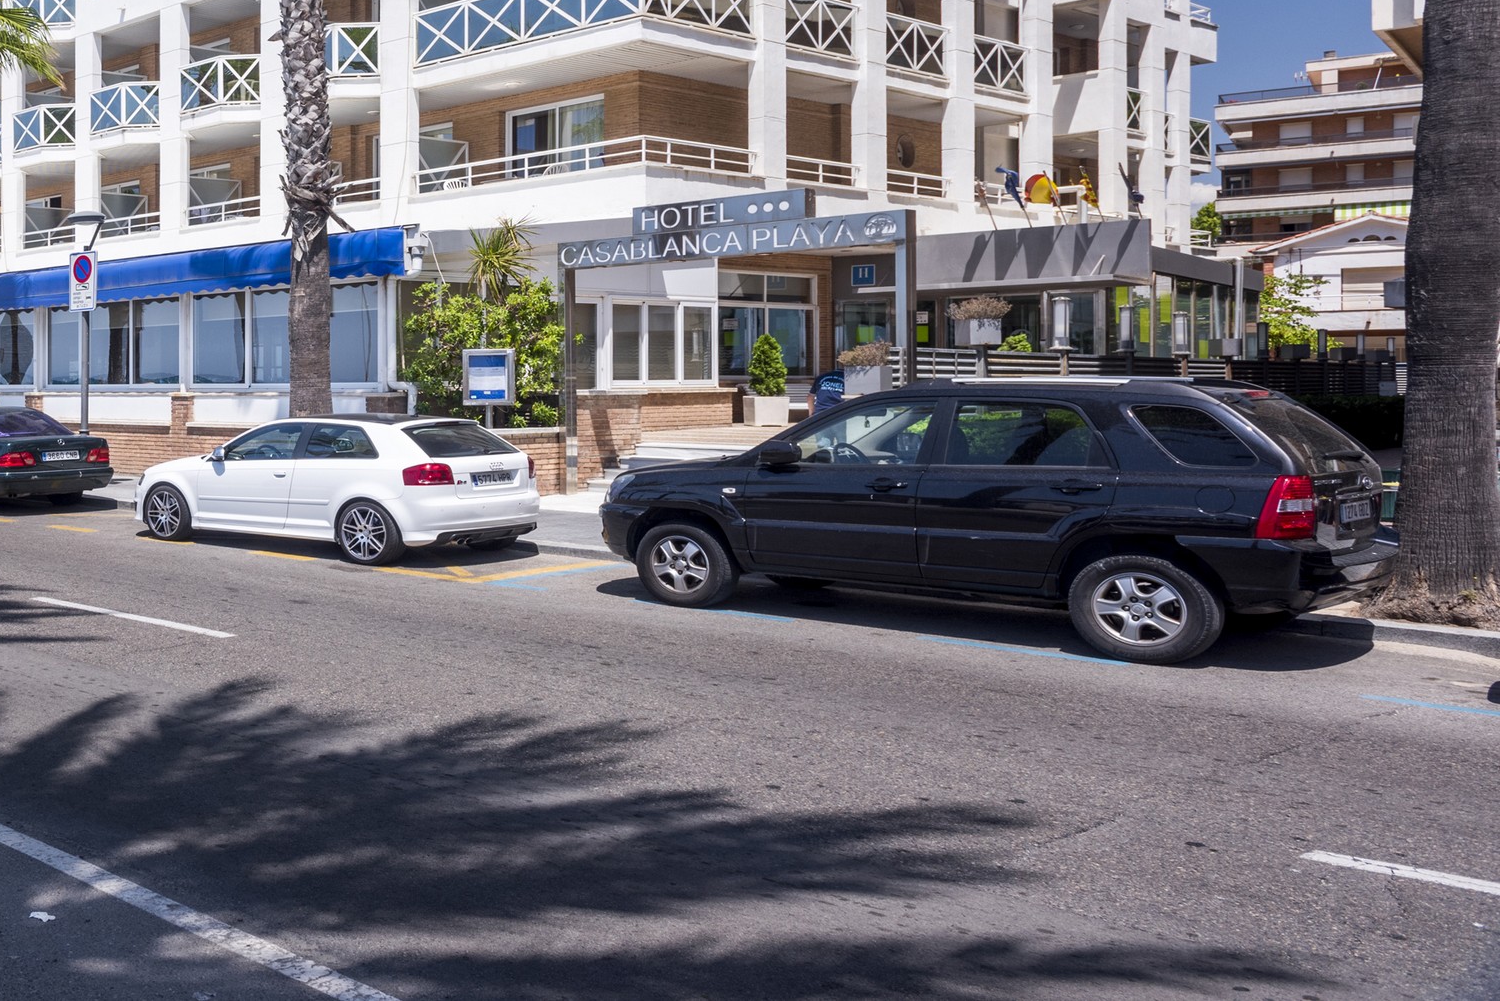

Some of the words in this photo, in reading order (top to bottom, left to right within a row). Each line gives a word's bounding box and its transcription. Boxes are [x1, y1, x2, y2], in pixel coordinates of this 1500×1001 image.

[641, 202, 734, 231] HOTEL
[560, 231, 742, 266] CASABLANCA
[752, 219, 855, 250] PLAYA
[859, 267, 868, 278] H
[477, 474, 497, 484] 5774
[498, 472, 512, 482] HPR
[1344, 504, 1358, 519] 1274
